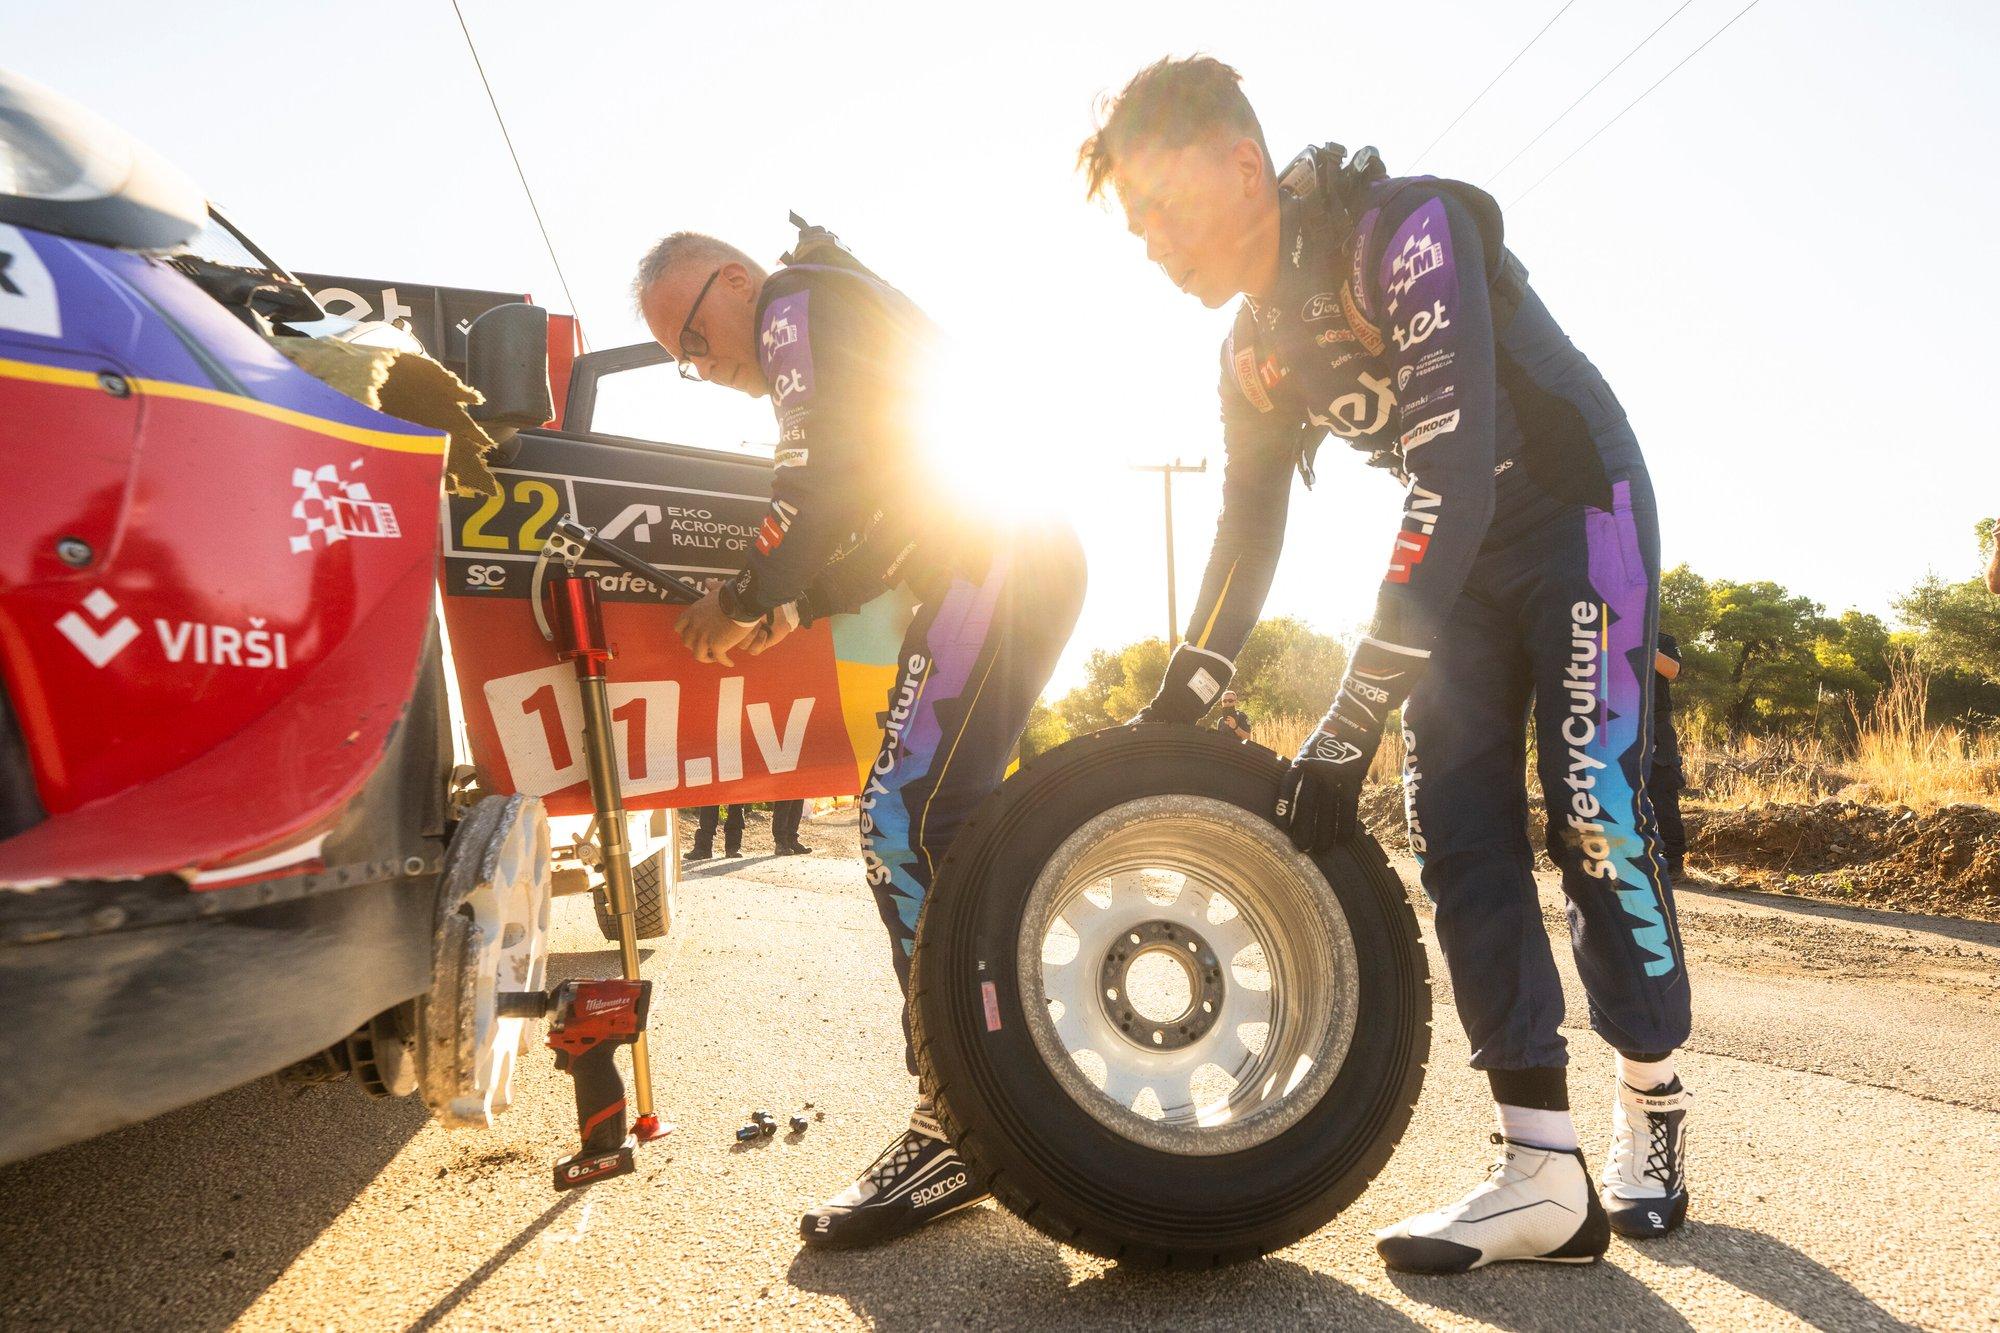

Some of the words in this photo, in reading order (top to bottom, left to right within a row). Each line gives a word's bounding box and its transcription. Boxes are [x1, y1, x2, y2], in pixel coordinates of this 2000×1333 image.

[1392, 299, 1450, 352] tet
[339, 501, 379, 535] M
[462, 480, 559, 551] 22
[667, 506, 713, 520] EKO
[670, 519, 761, 539] ACROPOLIS
[672, 533, 721, 549] RALLY
[725, 539, 748, 551] OF
[466, 564, 507, 586] SC
[155, 618, 288, 669] VIRŠI
[567, 1161, 591, 1178] 6.0
[911, 1172, 967, 1208] sparco
